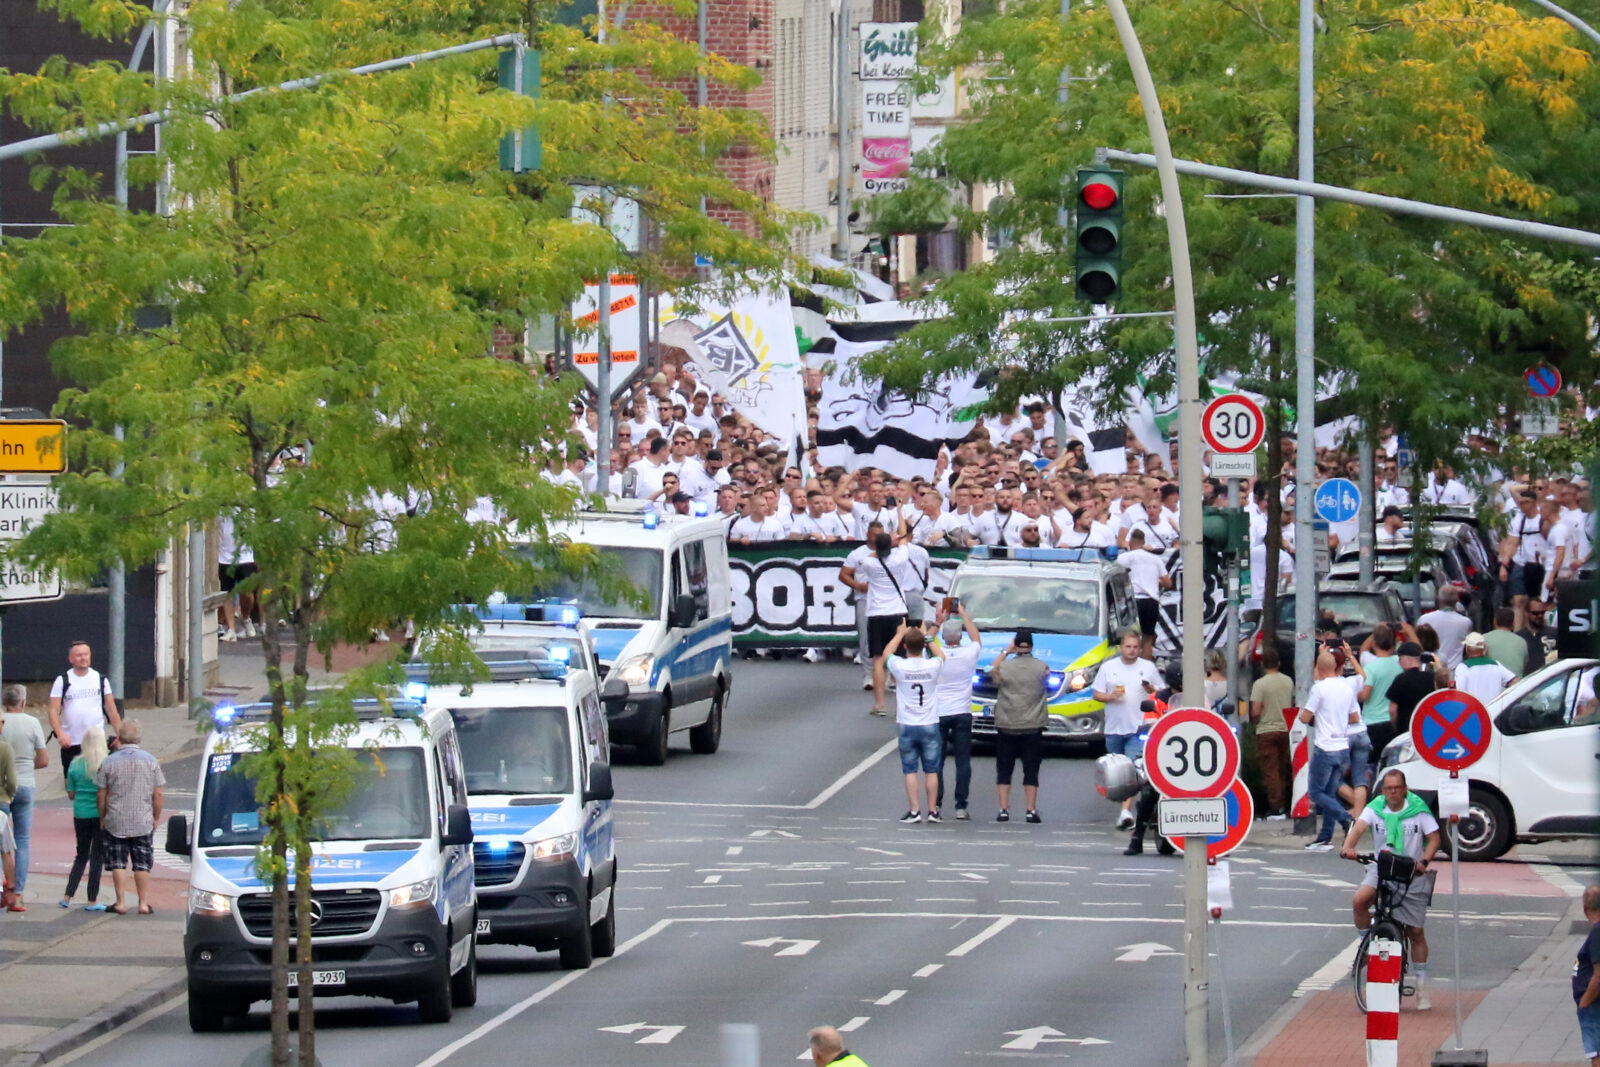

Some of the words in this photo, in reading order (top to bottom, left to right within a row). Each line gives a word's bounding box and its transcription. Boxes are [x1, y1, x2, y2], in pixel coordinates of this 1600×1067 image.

[864, 29, 915, 61] Grill
[866, 93, 907, 105] FREE
[868, 111, 903, 123] TIME
[865, 179, 906, 192] Gyros
[575, 352, 588, 362] Zu
[1216, 411, 1251, 439] 30
[1214, 461, 1251, 470] Lärmschutz
[1, 492, 55, 509] Klinik
[212, 754, 232, 762] NRW
[1165, 735, 1218, 777] 30
[1164, 811, 1219, 824] Lärmschutz
[320, 972, 344, 983] 5939
